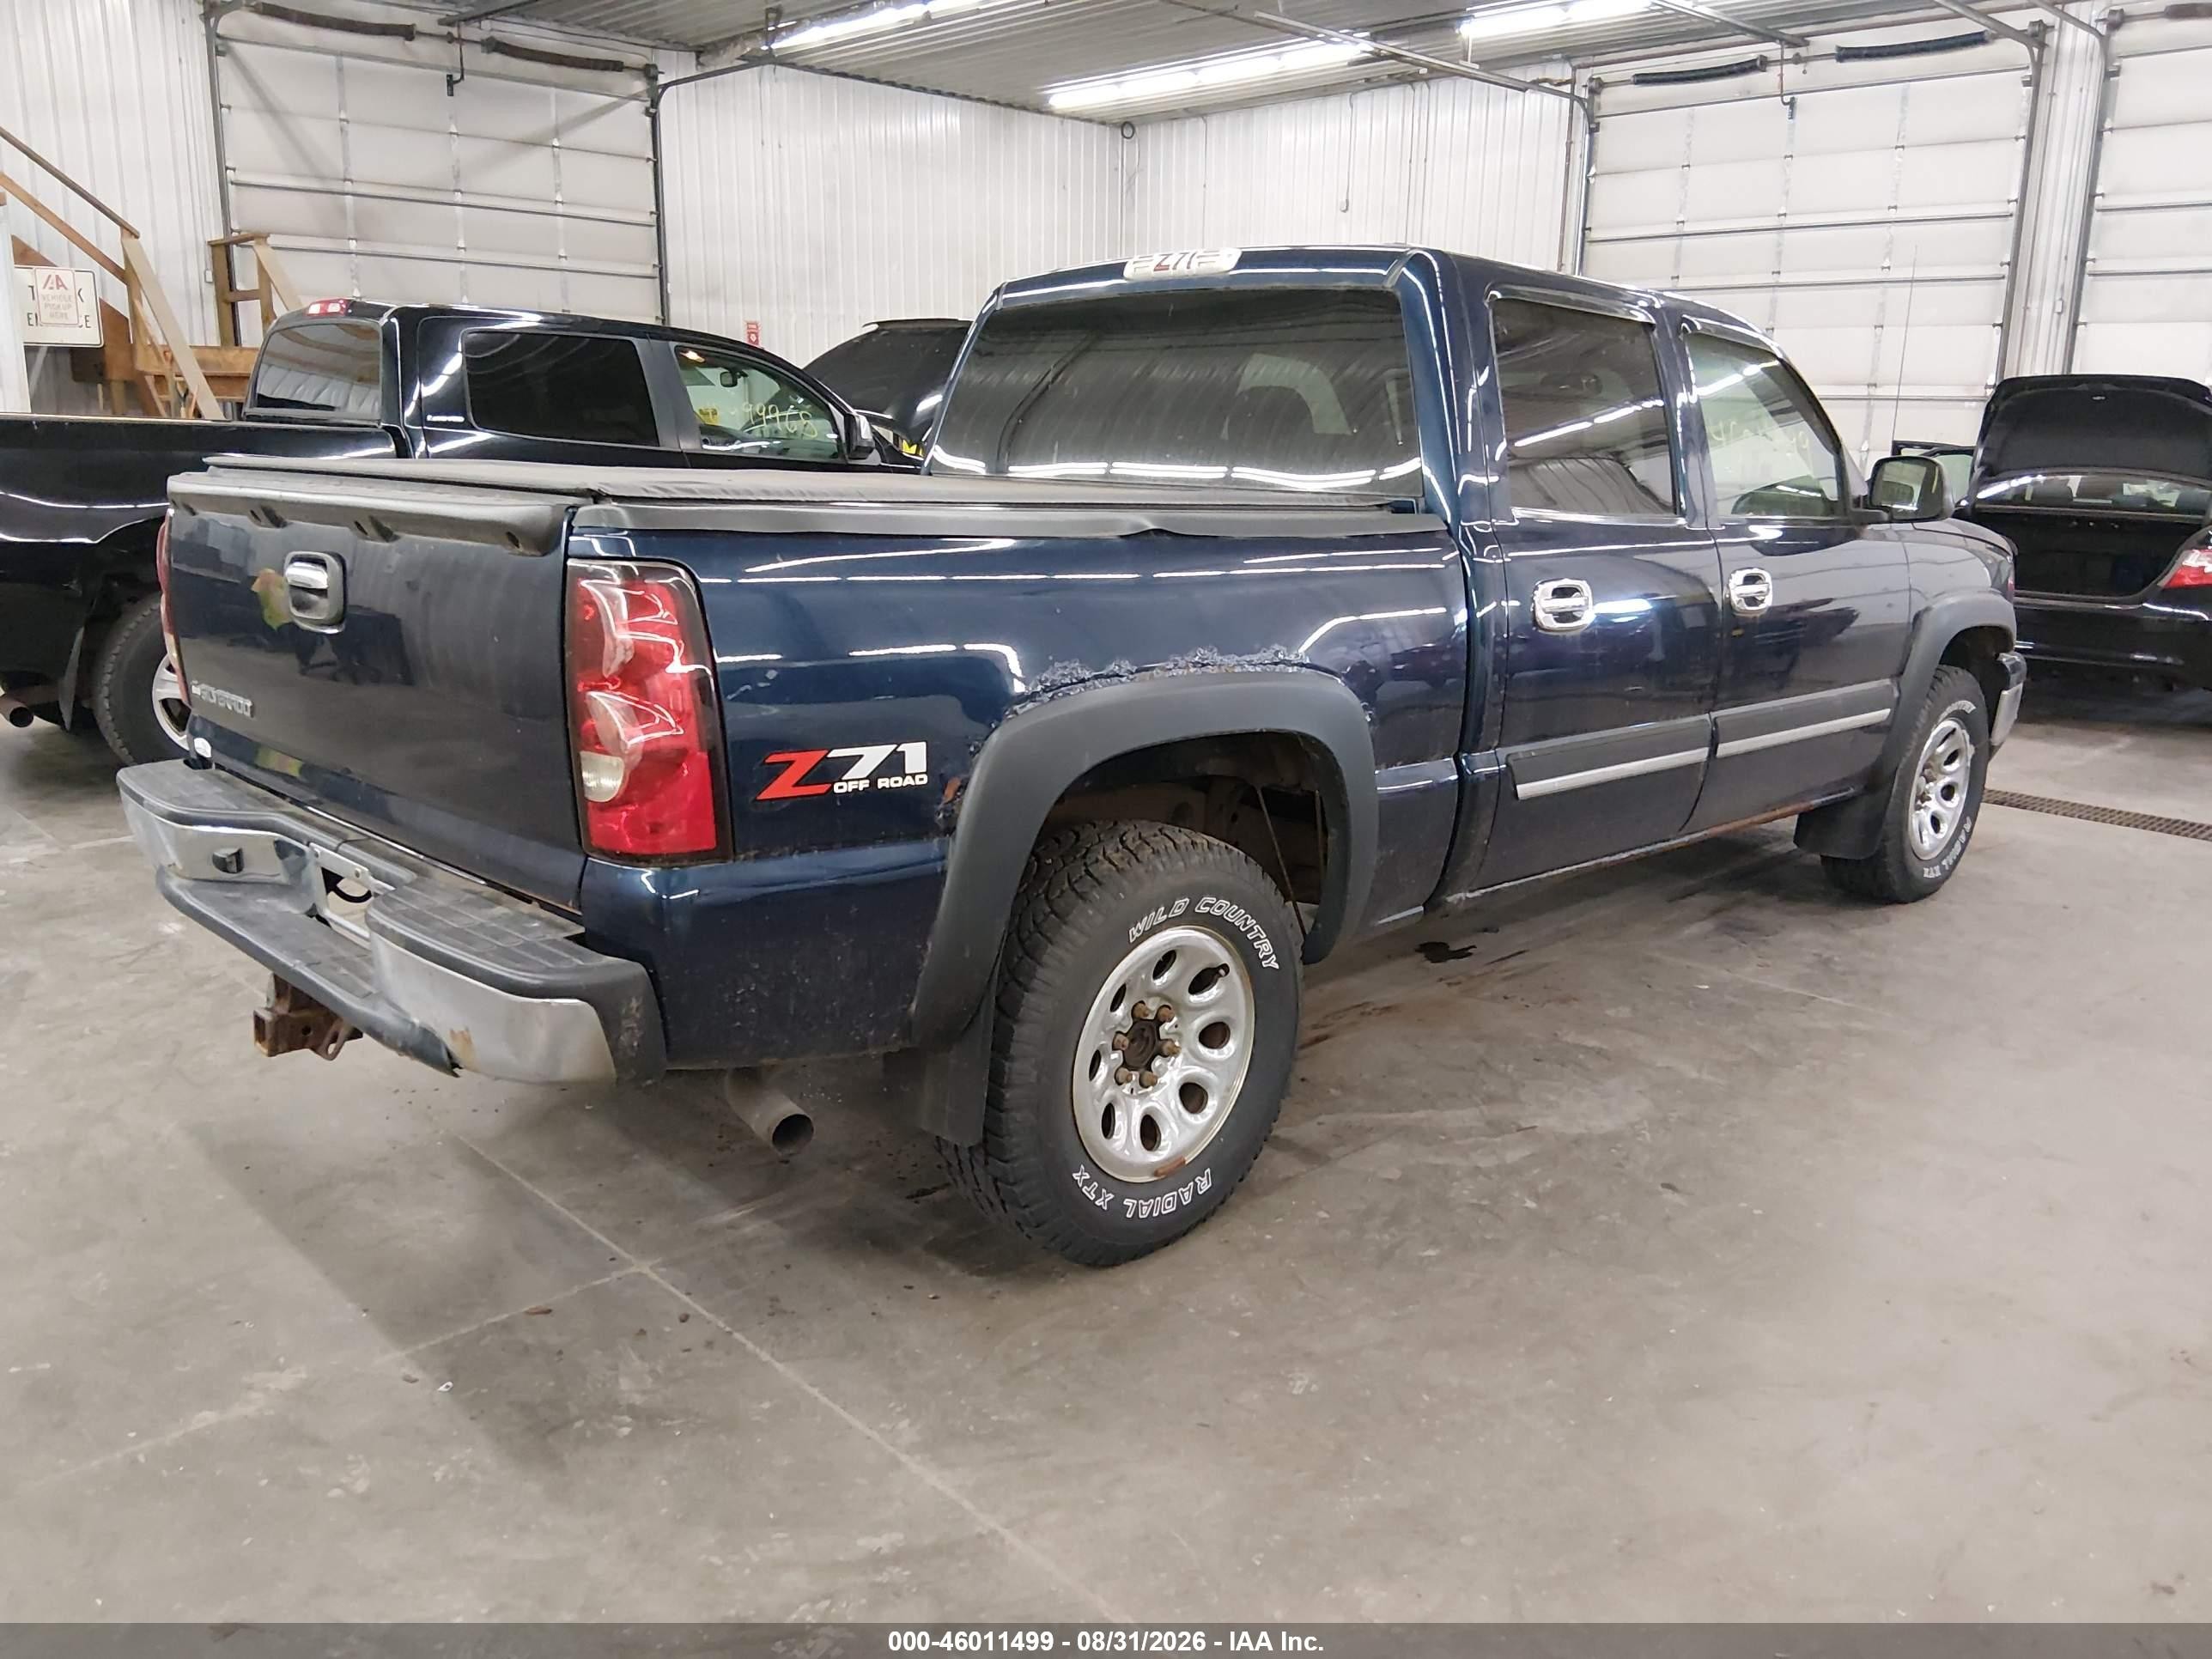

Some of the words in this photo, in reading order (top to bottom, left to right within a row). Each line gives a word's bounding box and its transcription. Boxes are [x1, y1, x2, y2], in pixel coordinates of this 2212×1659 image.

[1153, 251, 1198, 272] Z71
[755, 741, 927, 799] Z71
[834, 779, 870, 793] OFF
[878, 774, 928, 789] ROAD
[1129, 898, 1190, 943] WILD
[1194, 896, 1279, 969] COUNTRY
[1073, 1164, 1115, 1210] XTX
[1123, 1168, 1212, 1218] RADIAL
